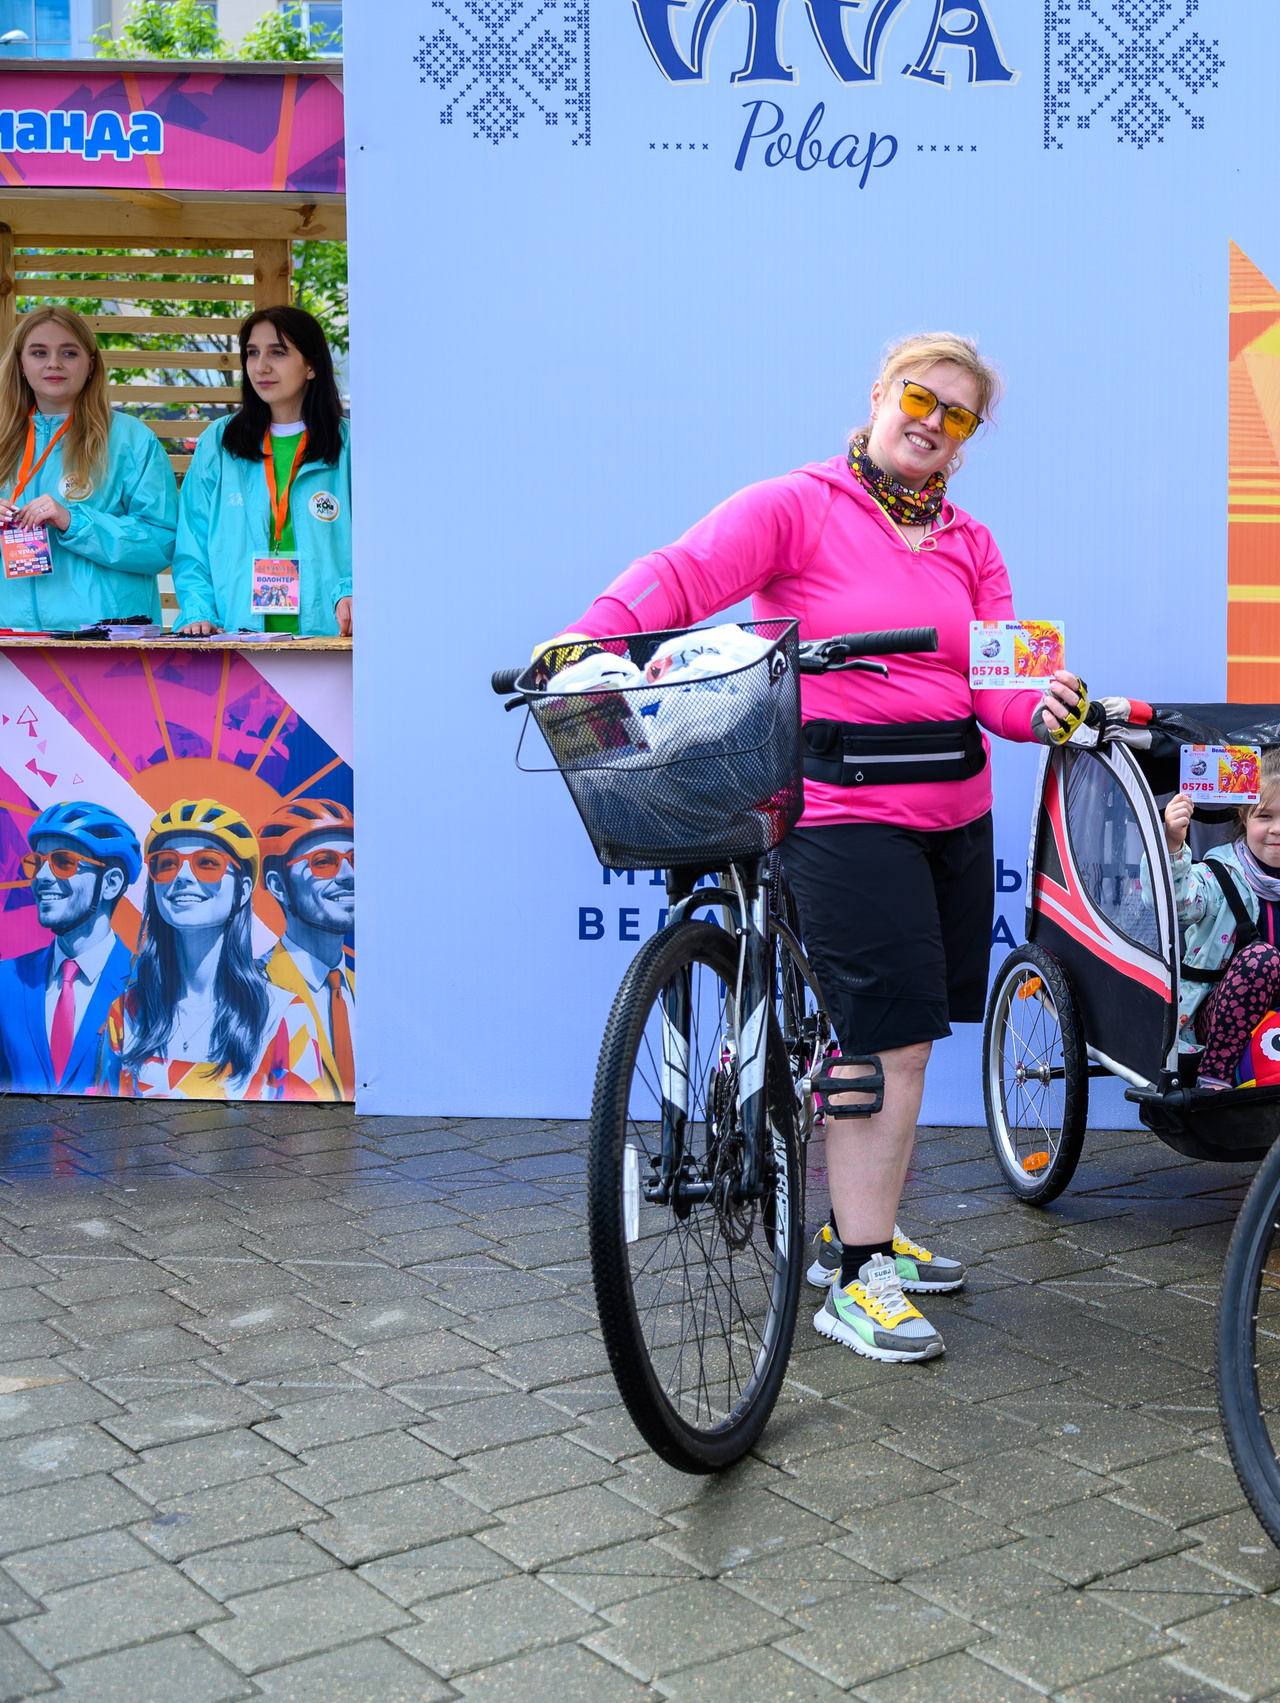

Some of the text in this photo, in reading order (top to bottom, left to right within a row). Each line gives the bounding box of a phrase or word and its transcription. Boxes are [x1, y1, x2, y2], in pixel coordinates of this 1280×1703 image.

[632, 0, 1021, 88] VIVA
[971, 666, 1010, 676] 05783
[1181, 782, 1215, 791] 05785
